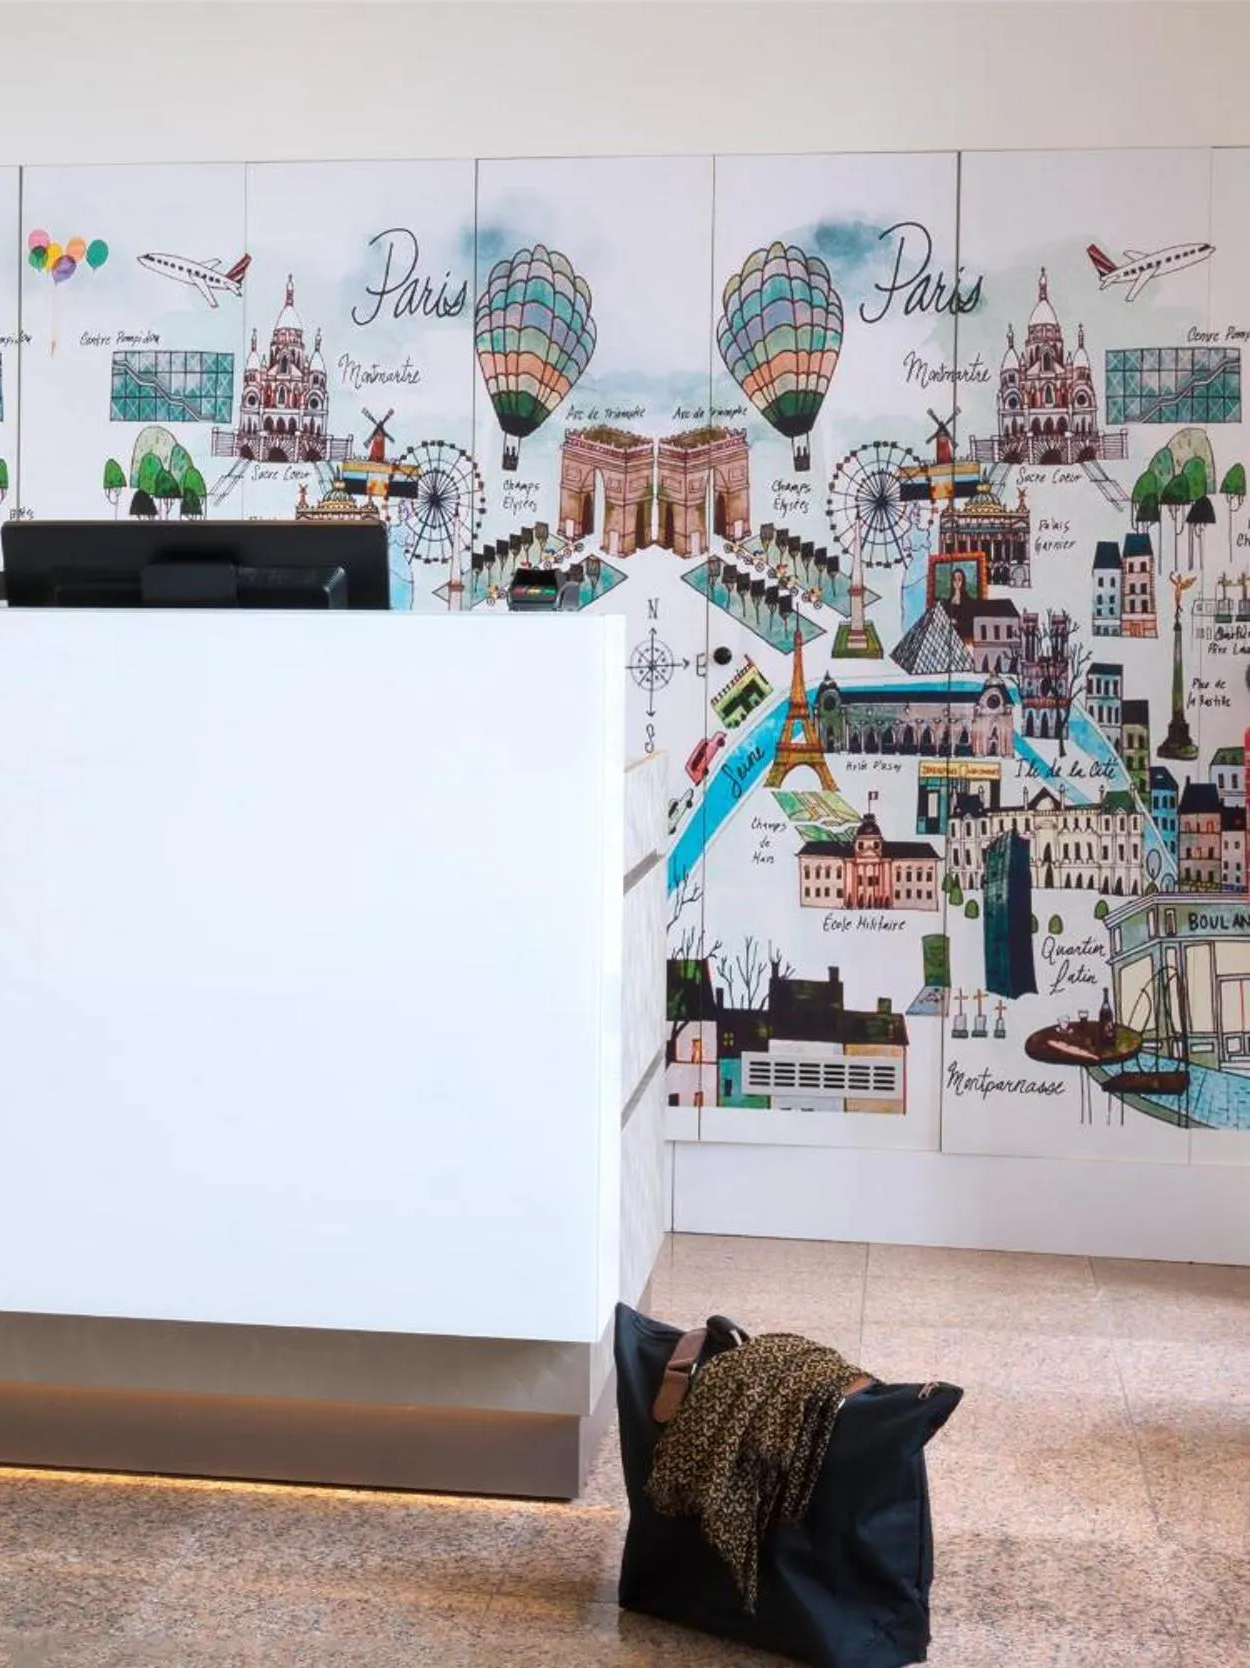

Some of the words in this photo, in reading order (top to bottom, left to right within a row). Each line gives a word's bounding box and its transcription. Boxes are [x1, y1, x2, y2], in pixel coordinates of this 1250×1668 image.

[351, 227, 468, 326] Paris
[860, 221, 983, 324] Paris
[337, 352, 421, 390] Montmartre
[903, 350, 991, 389] Montmartre
[648, 598, 659, 620] N
[721, 745, 765, 799] Seine
[1068, 760, 1087, 778] la
[1049, 959, 1098, 995] Latin
[946, 1060, 1067, 1100] Montparnasse
